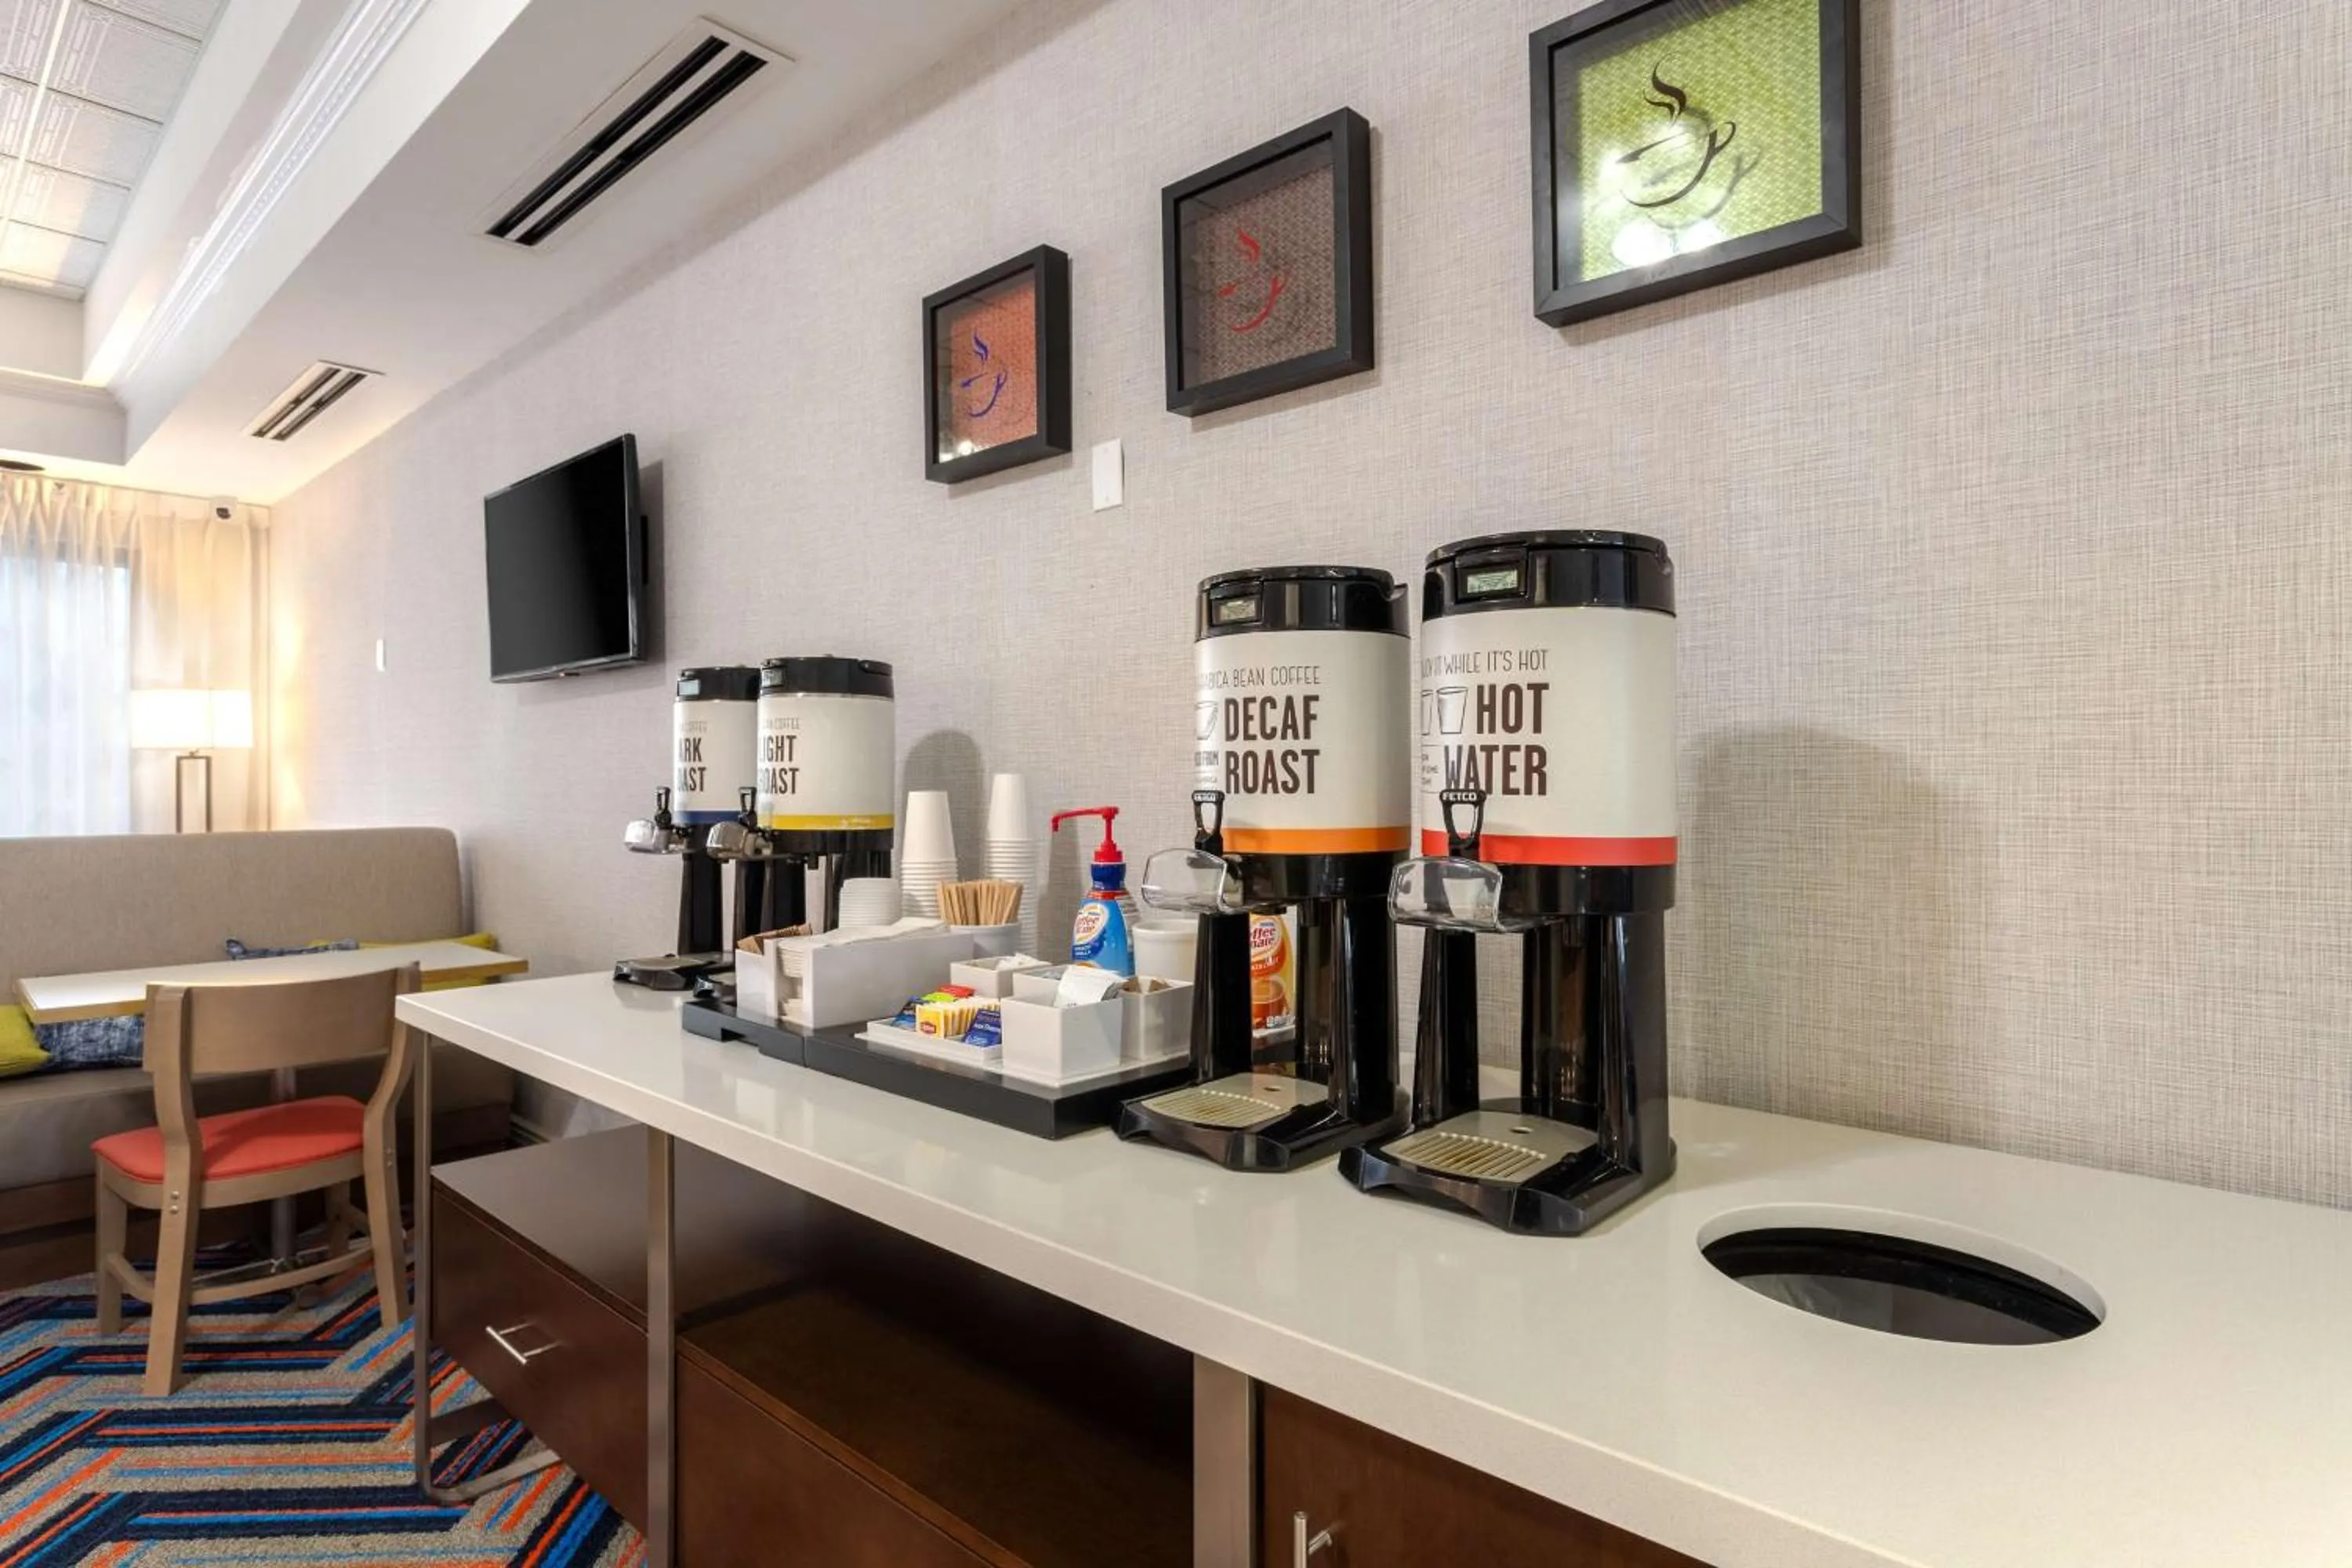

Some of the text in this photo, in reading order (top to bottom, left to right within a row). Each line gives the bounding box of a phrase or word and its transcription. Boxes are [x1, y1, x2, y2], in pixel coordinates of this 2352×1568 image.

[1232, 667, 1265, 688] BEAN
[1271, 666, 1321, 686] COFFEE
[1443, 652, 1481, 675] WHILE
[1487, 650, 1512, 672] IT'S
[1519, 649, 1548, 671] HOT
[1225, 695, 1319, 742] DECAF
[1476, 683, 1550, 735] HOT
[678, 737, 702, 762] ARK
[1225, 749, 1320, 794] ROAST
[1444, 744, 1548, 797] WATER
[1250, 927, 1276, 940] ffee
